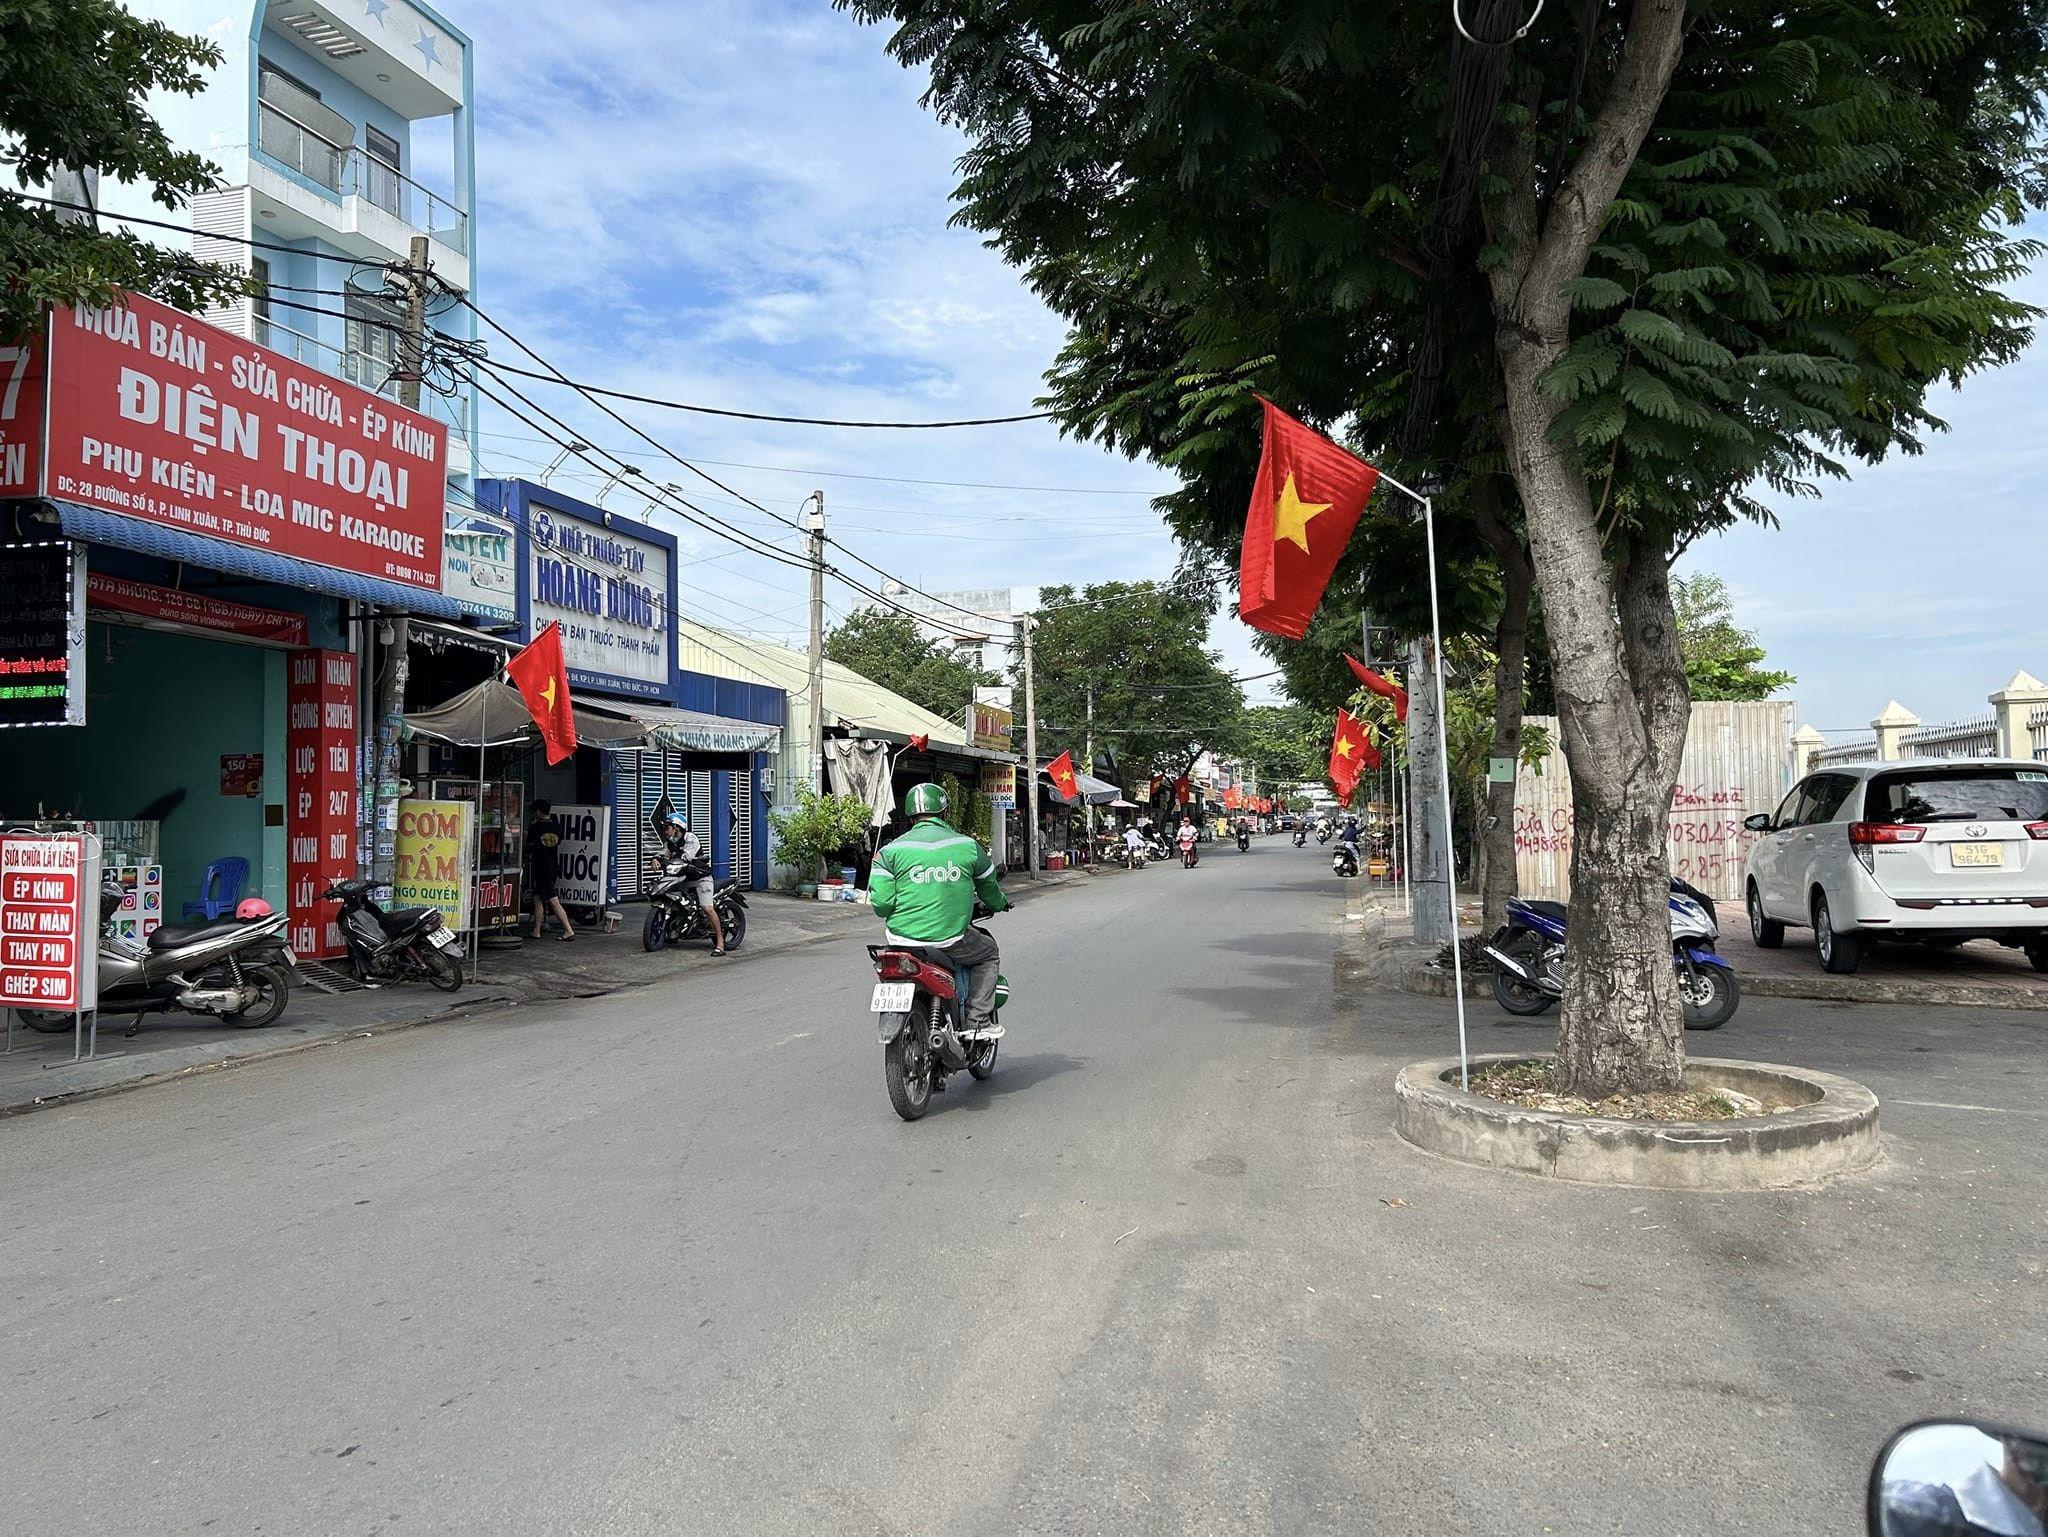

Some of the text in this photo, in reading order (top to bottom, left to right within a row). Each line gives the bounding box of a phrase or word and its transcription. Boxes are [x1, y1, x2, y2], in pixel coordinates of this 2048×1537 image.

[74, 297, 141, 349] MUA
[150, 320, 206, 374] BÁN
[231, 352, 279, 403] SỬA
[286, 377, 343, 428] CHỮA
[362, 404, 387, 441] ÉP
[391, 419, 435, 462] KÍNH
[117, 366, 408, 512] ĐIỆN THOẠI
[0, 430, 26, 485] N
[57, 475, 271, 544] ĐC: 28 ĐƯỜNG SỐ 8, P. LINH XUÂN, TP. THỦ ĐỨC
[82, 436, 143, 483] PHỤ
[151, 456, 216, 499] KIỆN
[240, 484, 285, 520] LOA
[292, 499, 334, 533] MIC
[340, 514, 425, 559] KARAOKE
[559, 524, 645, 574] NHÀ THUỐC TÂY
[412, 569, 424, 583] 714
[186, 596, 201, 610] GB
[493, 607, 514, 621] 3209
[589, 627, 614, 647] THUỐC
[617, 635, 639, 654] THÀNH
[294, 654, 316, 685] DÁN
[326, 656, 352, 692] NHẬN
[292, 697, 319, 729] CƯỜNG
[325, 695, 353, 730] CHUYỂN
[713, 730, 745, 749] HOÀNG
[295, 745, 316, 779] LỰC
[298, 787, 312, 819] ÉP
[329, 790, 349, 816] 24/7
[398, 808, 459, 840] CƠM
[292, 831, 318, 863] KÍNH
[330, 829, 348, 860] RÚT
[1965, 844, 1988, 855] 51G
[398, 843, 458, 881] TẤM
[558, 845, 600, 882] UỐC
[909, 860, 962, 884] Grab
[13, 877, 65, 900] ÉP KÍNH
[295, 873, 315, 908] LẤY
[420, 884, 459, 901] QUYỀN
[6, 909, 70, 932] THAY MÀN
[293, 918, 316, 953] LIỀN
[8, 941, 66, 962] THAY PIN
[4, 973, 67, 997] GHÉP SIM
